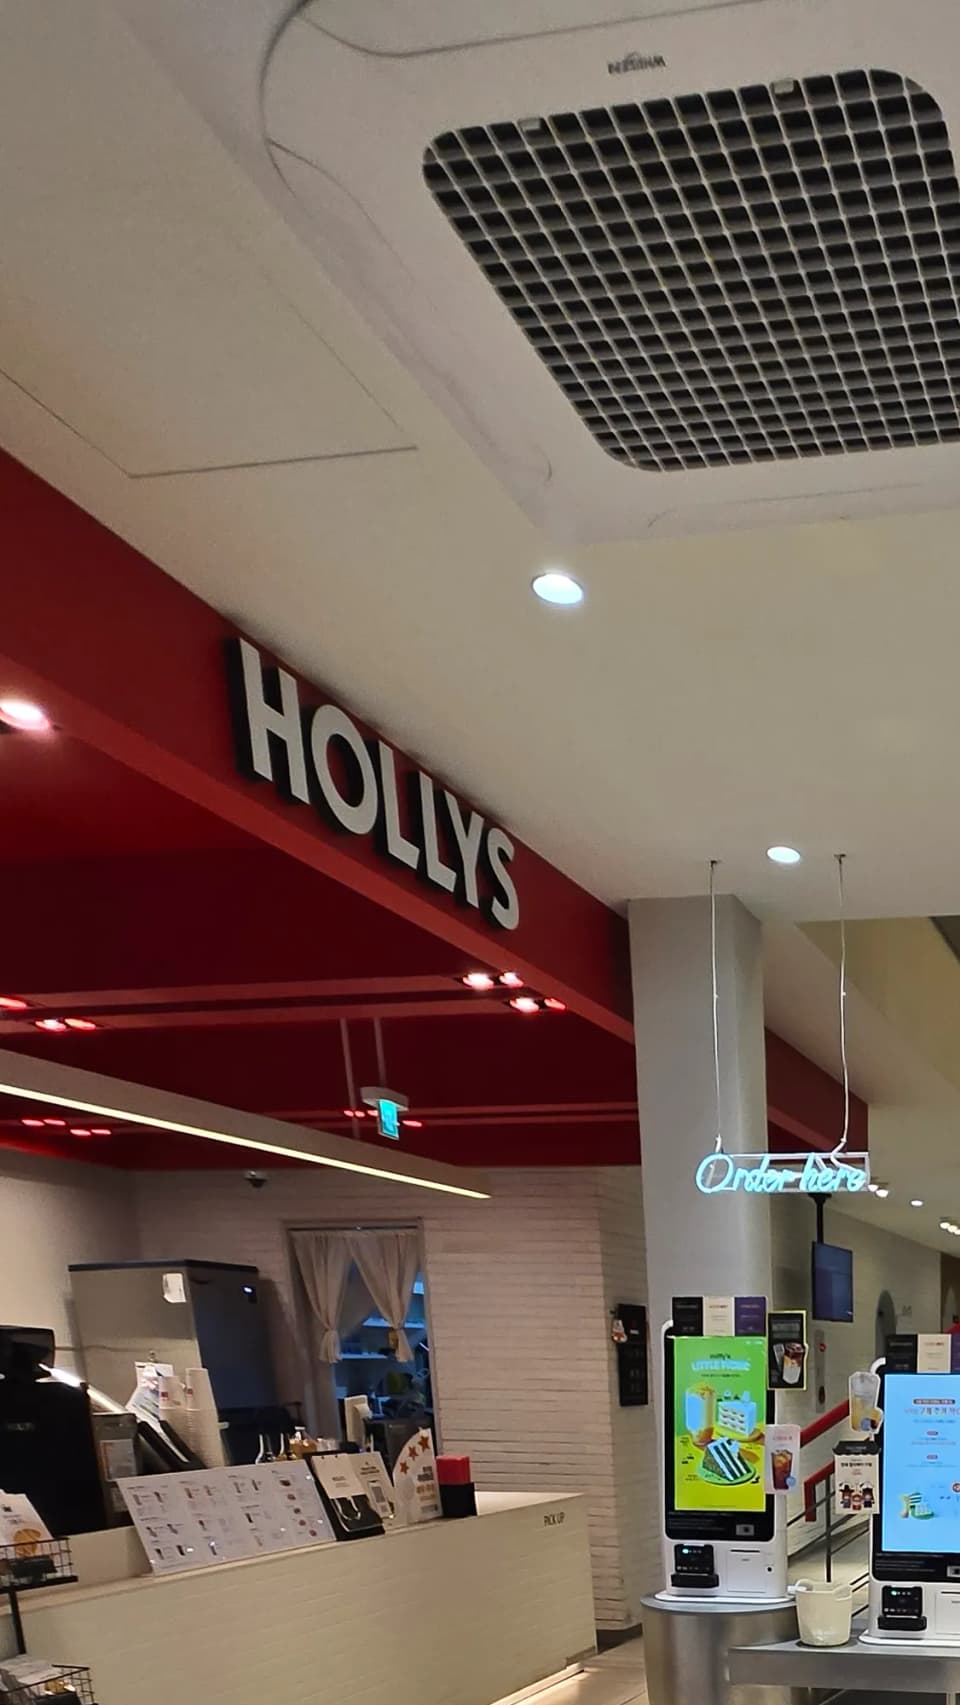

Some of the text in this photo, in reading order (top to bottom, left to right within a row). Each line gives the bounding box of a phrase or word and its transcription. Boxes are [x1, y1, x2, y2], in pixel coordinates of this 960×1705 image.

[239, 637, 519, 930] HOLLYS
[696, 1152, 867, 1193] Order here
